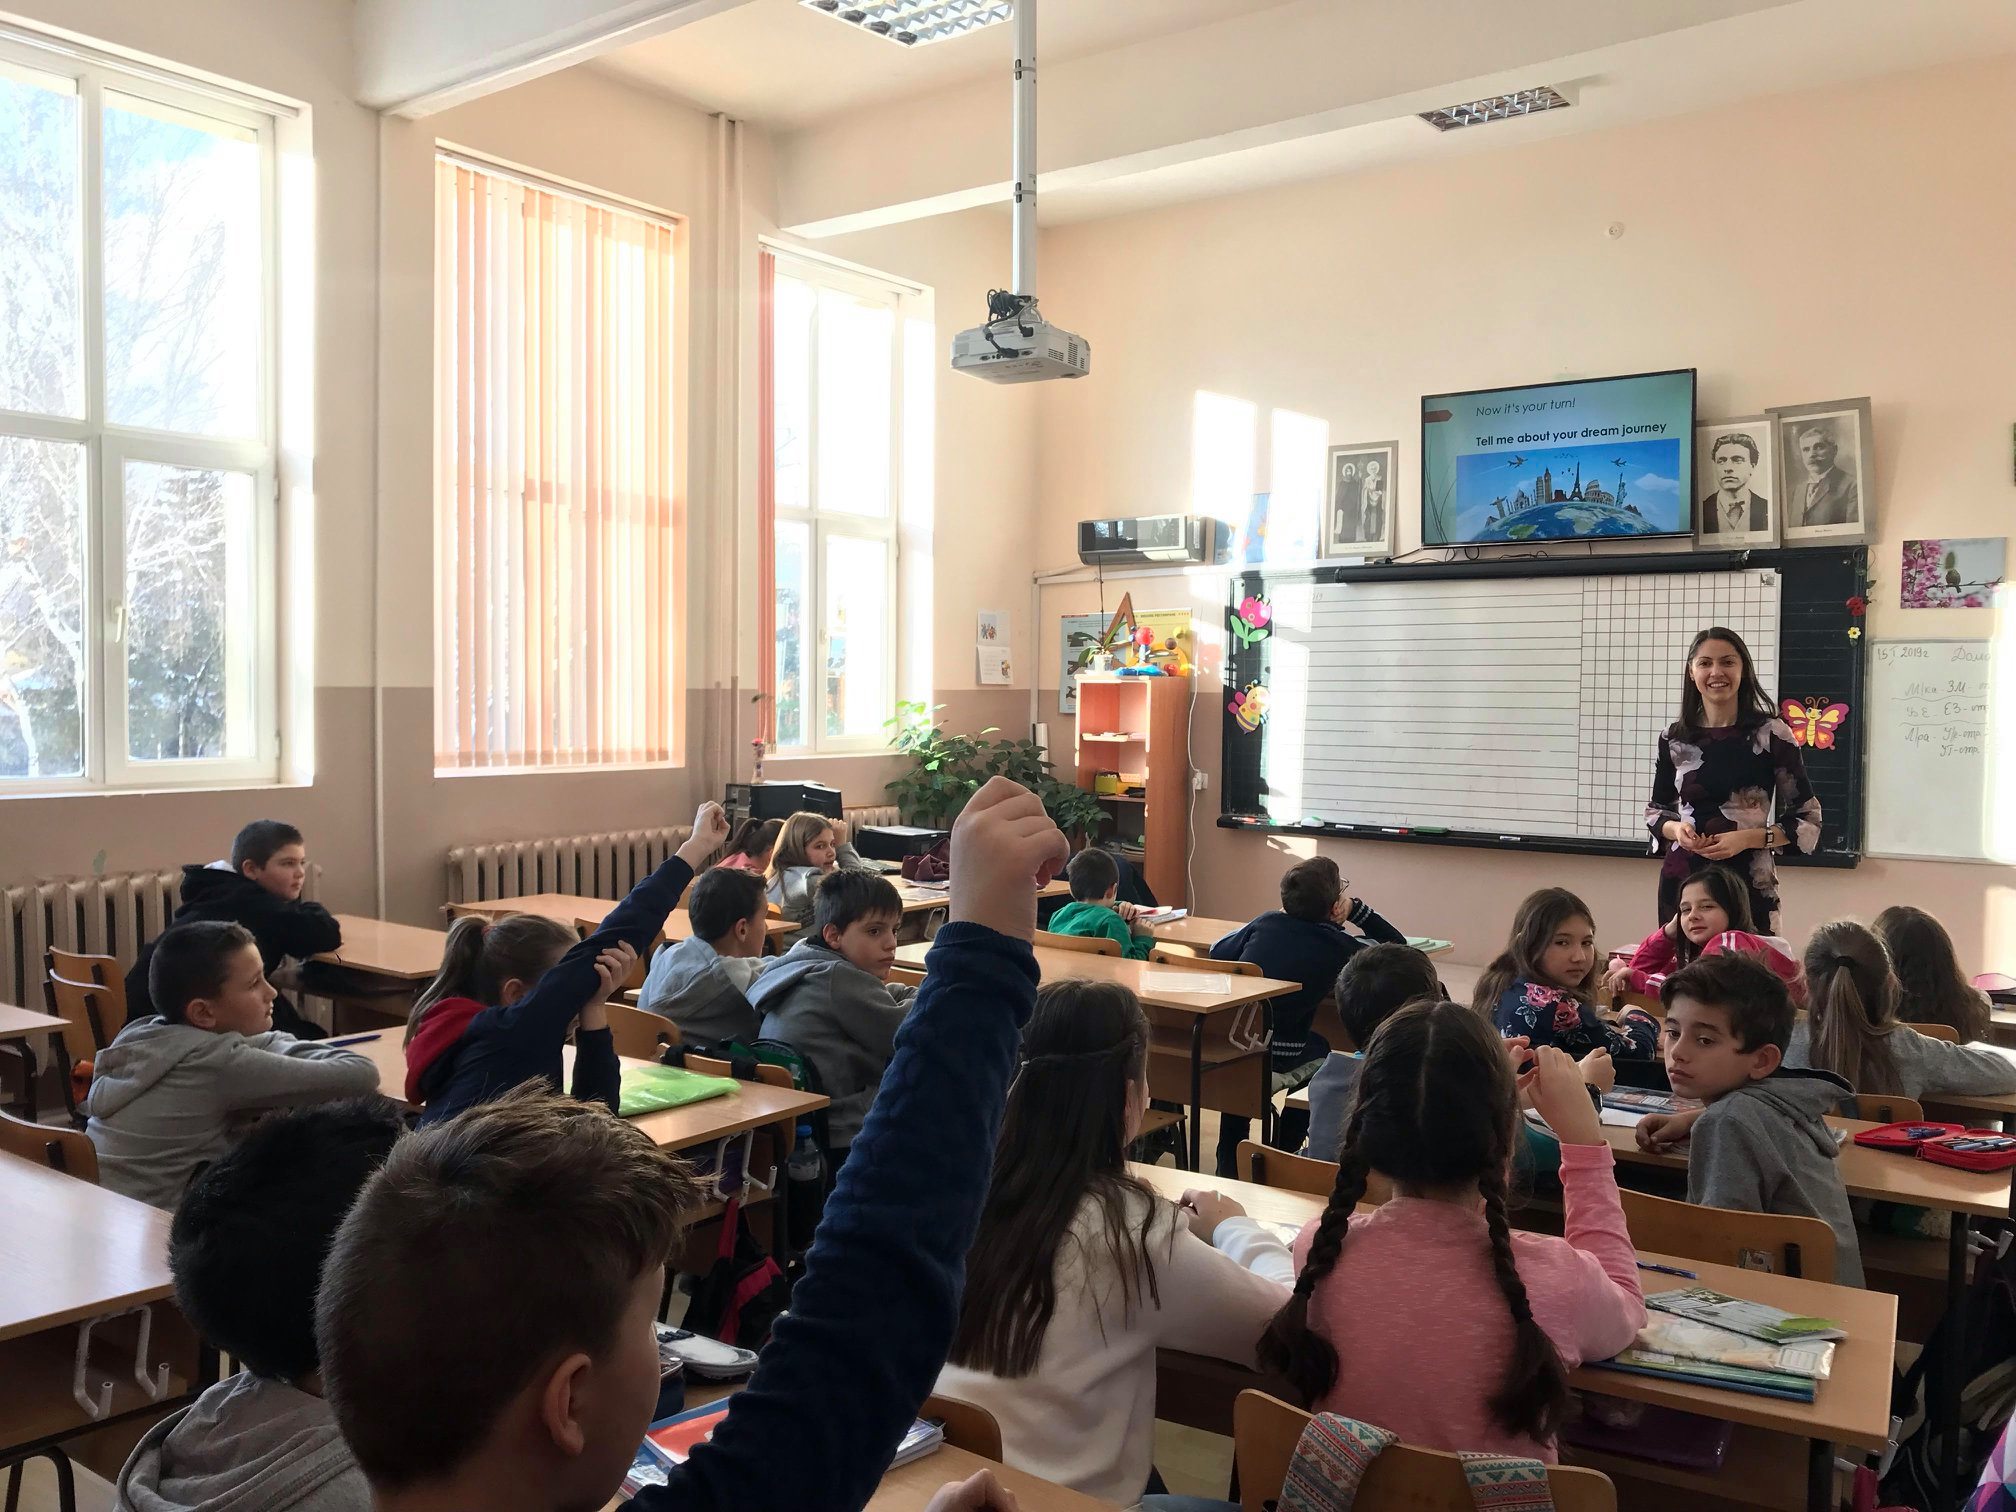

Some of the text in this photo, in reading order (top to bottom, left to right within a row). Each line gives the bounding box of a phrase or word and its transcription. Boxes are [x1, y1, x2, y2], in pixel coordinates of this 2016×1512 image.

[1476, 397, 1576, 417] Now it's your turn!
[1476, 423, 1667, 447] Tell me about your dream journey
